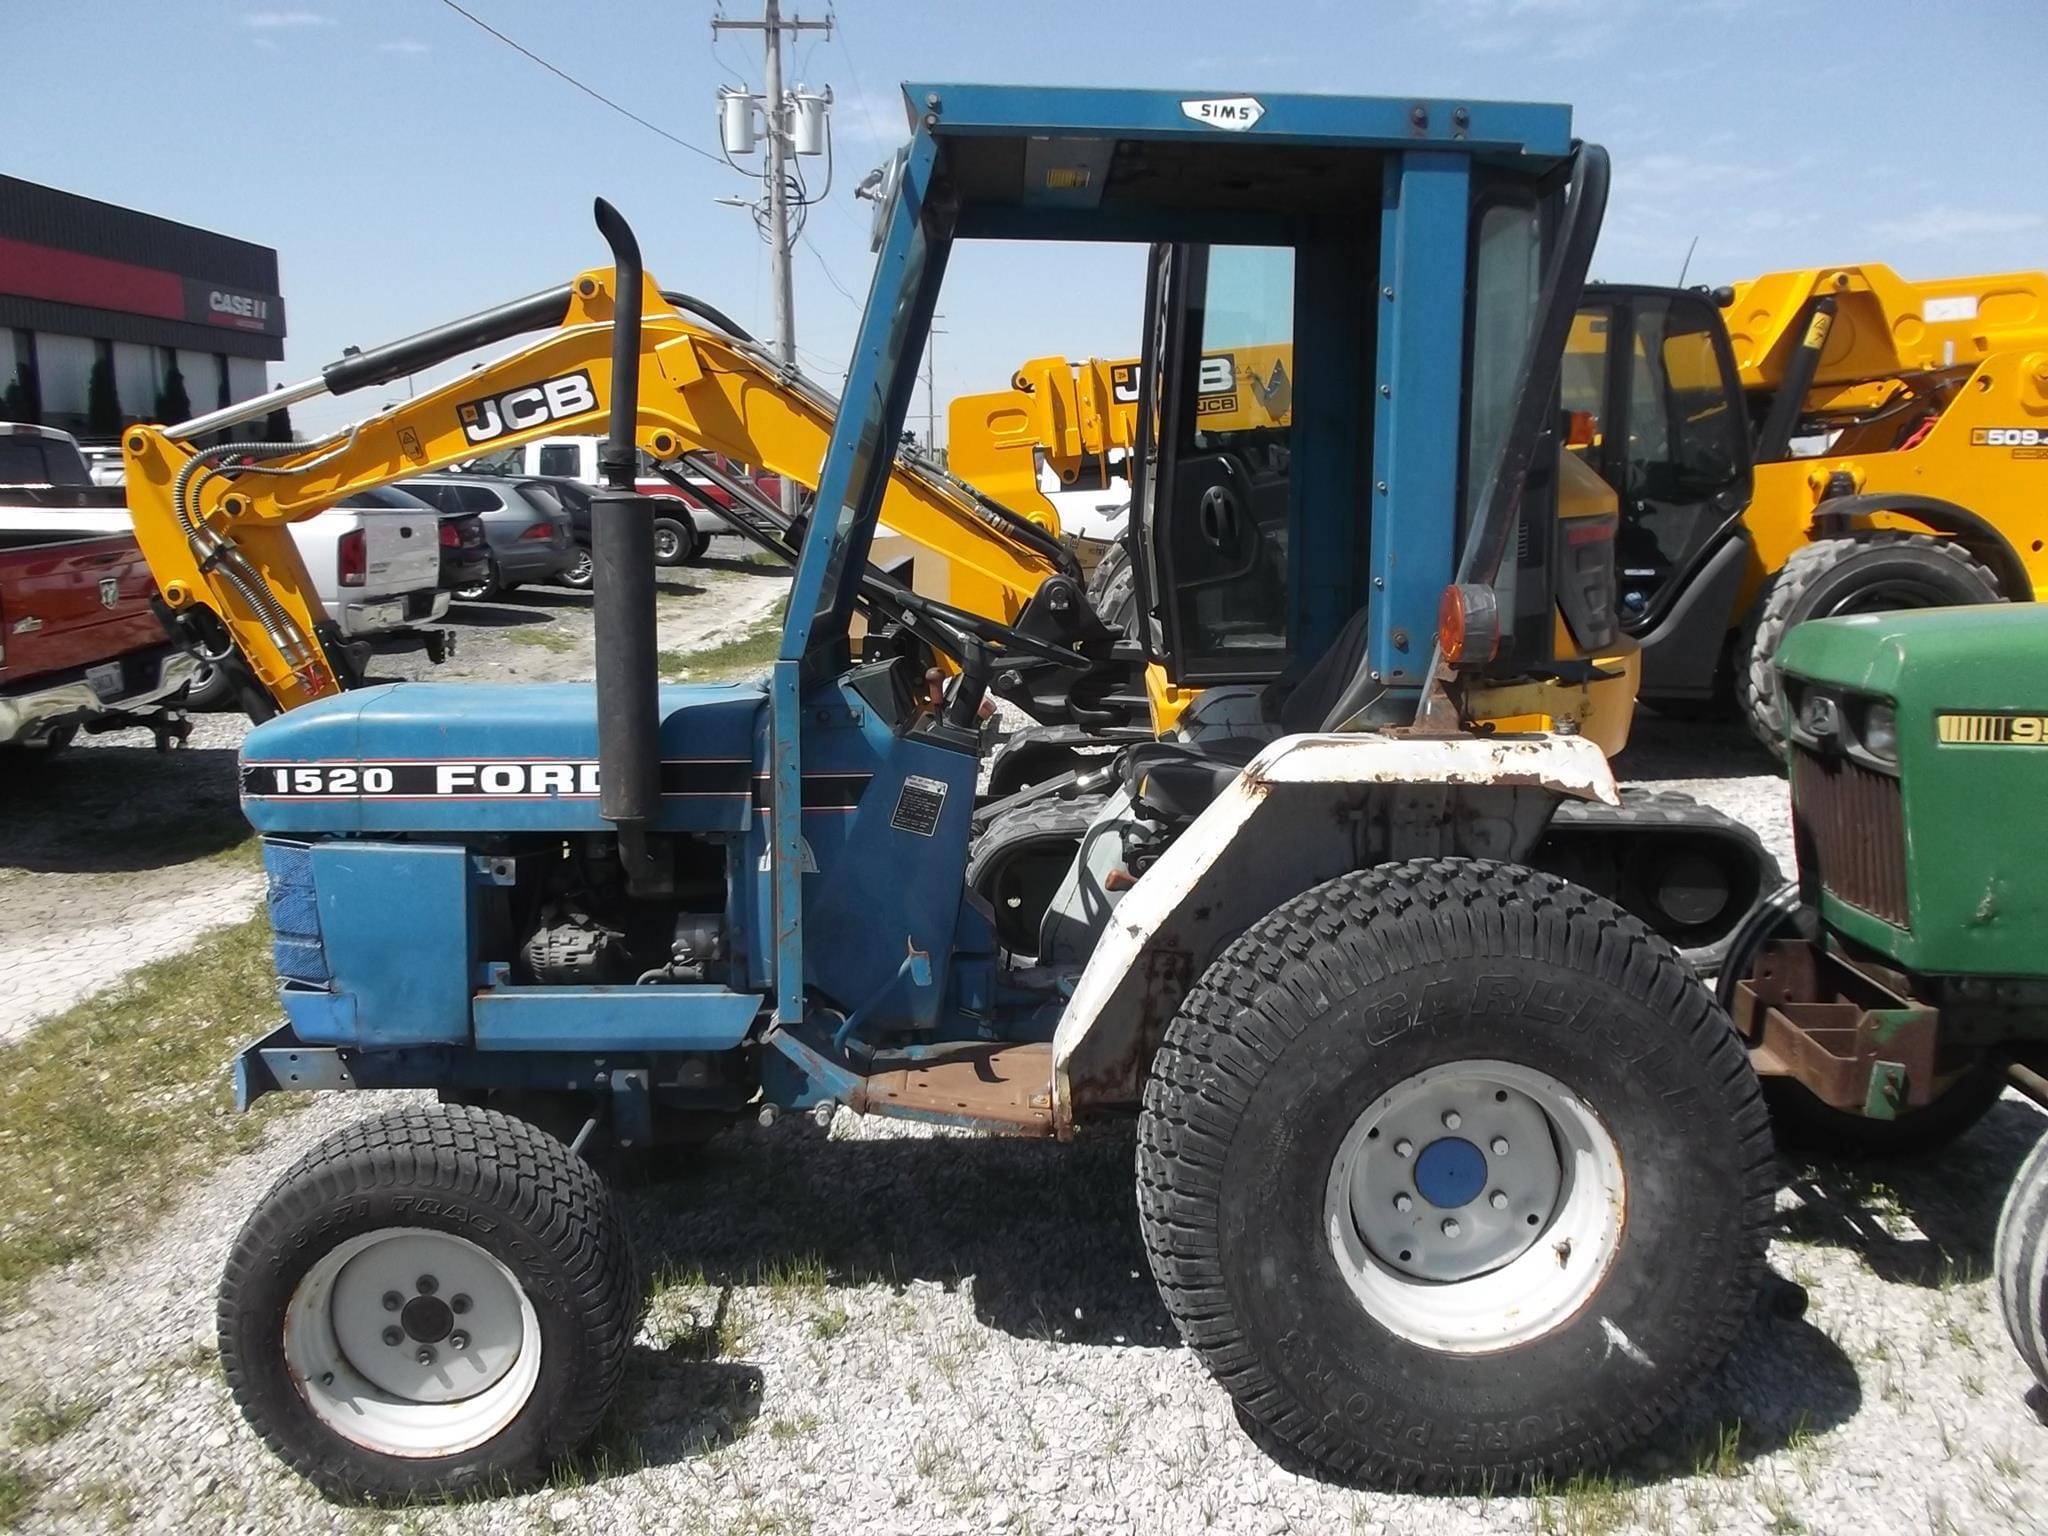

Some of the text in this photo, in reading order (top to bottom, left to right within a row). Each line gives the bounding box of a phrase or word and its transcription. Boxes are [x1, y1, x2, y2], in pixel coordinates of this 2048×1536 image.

[1201, 104, 1249, 120] SIMS
[209, 290, 253, 317] CASE
[467, 375, 594, 441] JCB
[2011, 716, 2048, 744] 9
[275, 767, 394, 794] 1520
[1362, 974, 1701, 1132] CARLISLE
